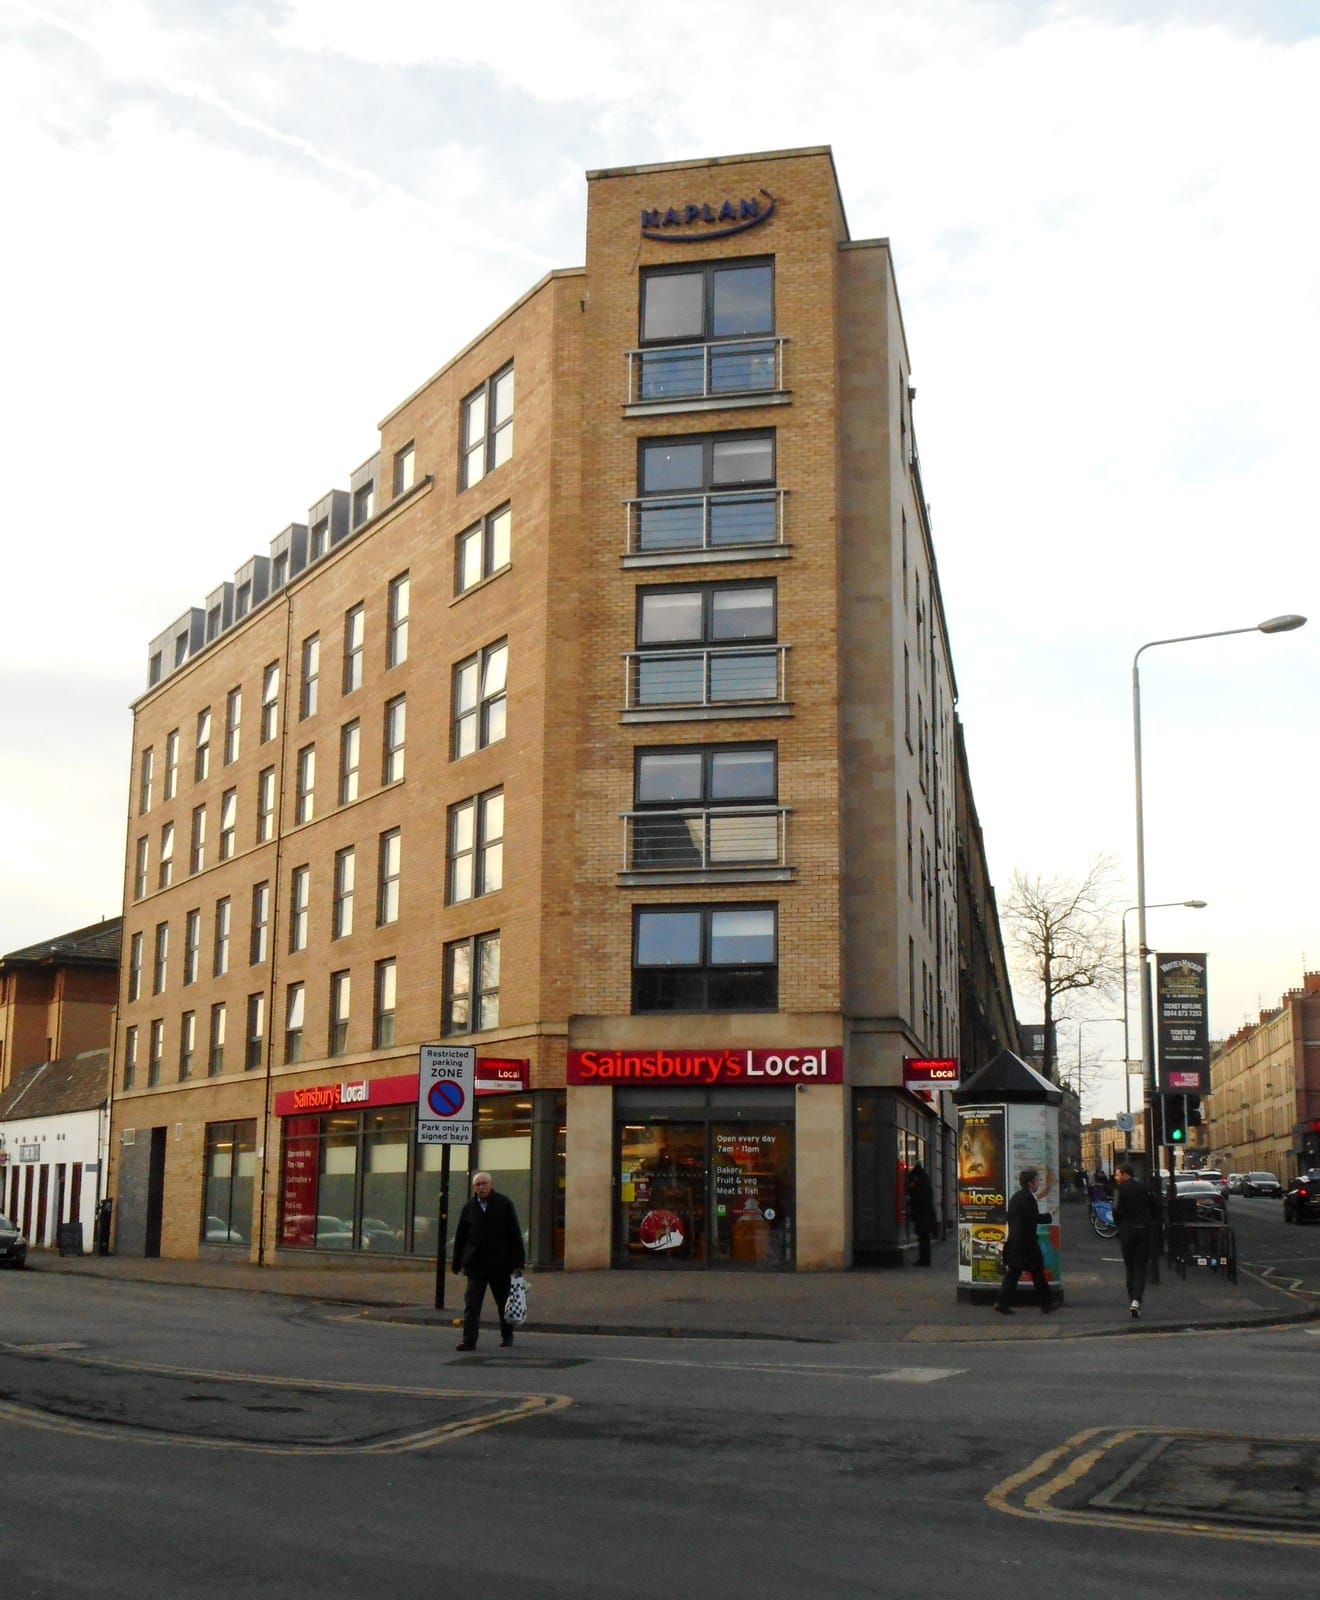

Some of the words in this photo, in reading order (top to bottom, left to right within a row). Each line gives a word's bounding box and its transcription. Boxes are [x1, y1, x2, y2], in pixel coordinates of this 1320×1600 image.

[641, 196, 759, 229] KAPLAN
[427, 1049, 469, 1058] Restricted
[432, 1059, 463, 1068] parking
[581, 1051, 741, 1083] Sainsbury's
[747, 1049, 827, 1076] Local
[431, 1068, 463, 1078] ZONE
[498, 1069, 520, 1078] Local
[930, 1069, 956, 1078] Local
[294, 1086, 340, 1109] Sainsbury's
[341, 1080, 369, 1104] Local
[421, 1123, 440, 1131] Park
[442, 1124, 459, 1133] only
[461, 1124, 470, 1132] in
[421, 1132, 448, 1141] signed
[450, 1132, 469, 1141] bays
[716, 1135, 737, 1143] Open
[761, 1135, 776, 1143] day
[741, 1145, 760, 1153] 11pm
[716, 1166, 742, 1174] Bakery
[745, 1187, 759, 1195] fish
